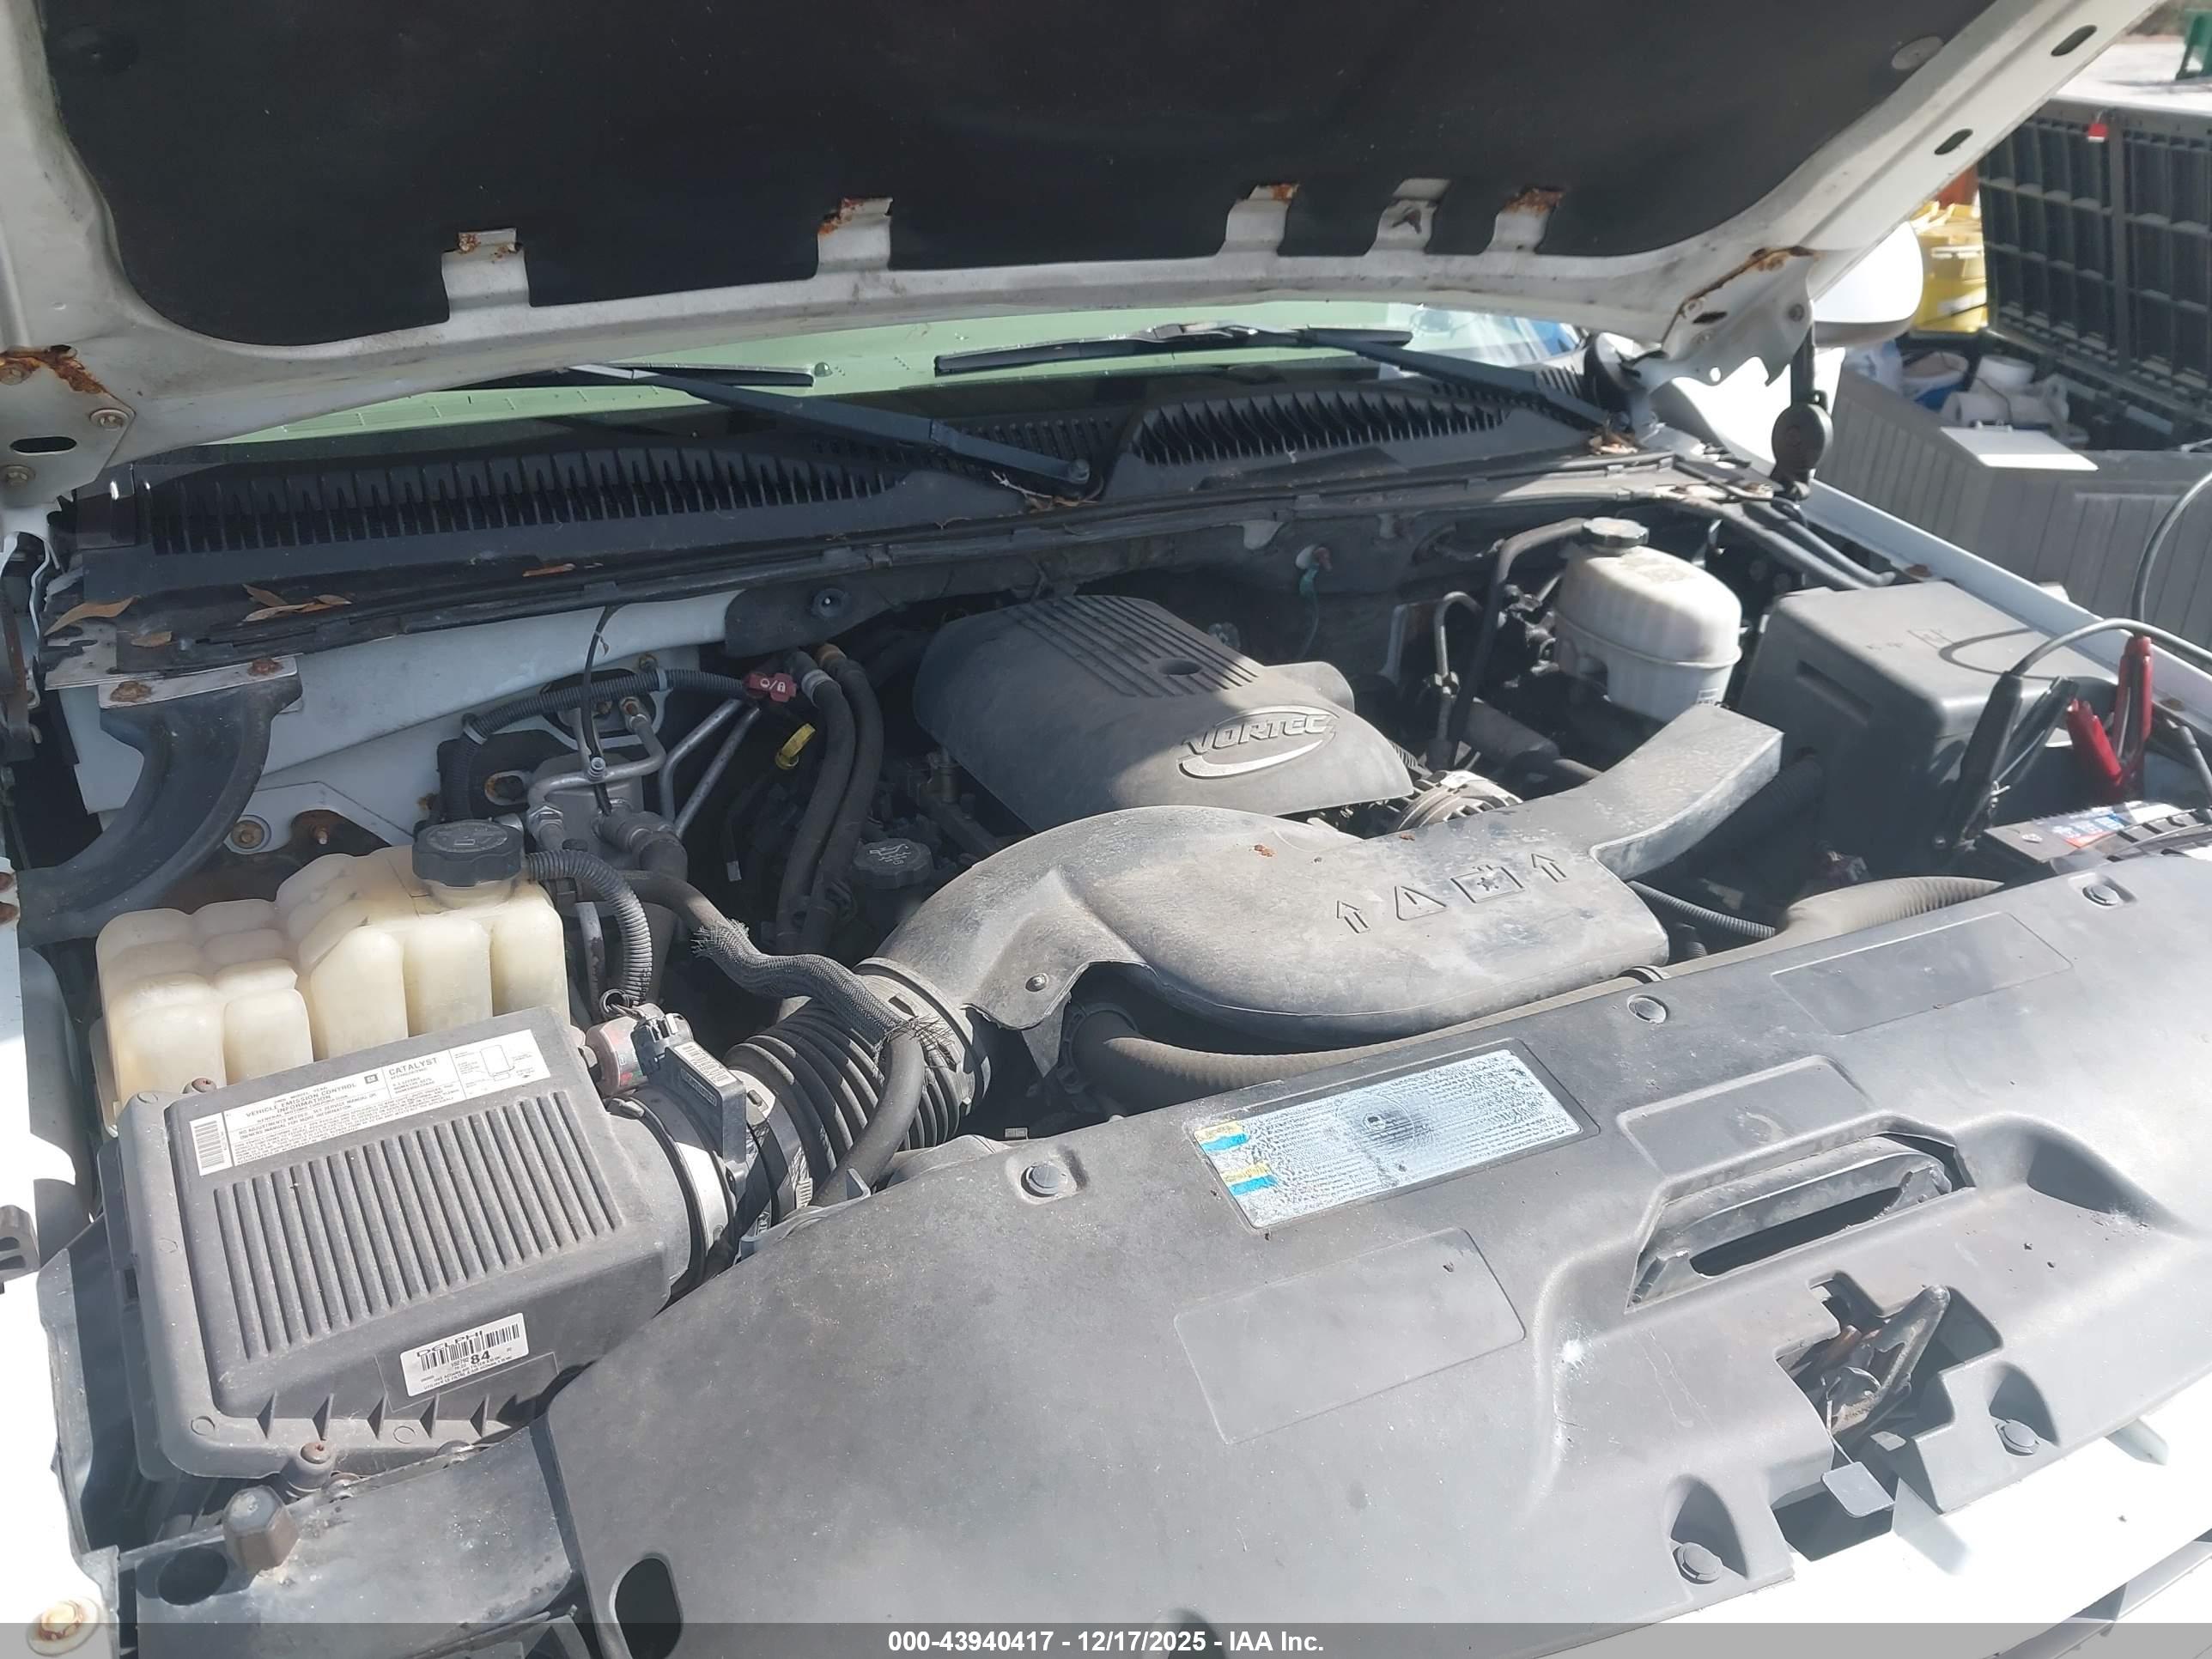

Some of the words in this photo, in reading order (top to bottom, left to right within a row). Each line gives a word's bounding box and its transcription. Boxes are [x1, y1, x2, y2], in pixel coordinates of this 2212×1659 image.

[1182, 714, 1334, 755] VORTEC
[387, 1056, 437, 1076] CATALYST
[245, 1103, 278, 1118] VEHICLE
[280, 1092, 319, 1108] EMISSION
[320, 1081, 357, 1096] CONTROL
[276, 1094, 331, 1113] INFORMATION
[416, 1330, 482, 1357] DELPHI
[469, 1349, 490, 1365] 84
